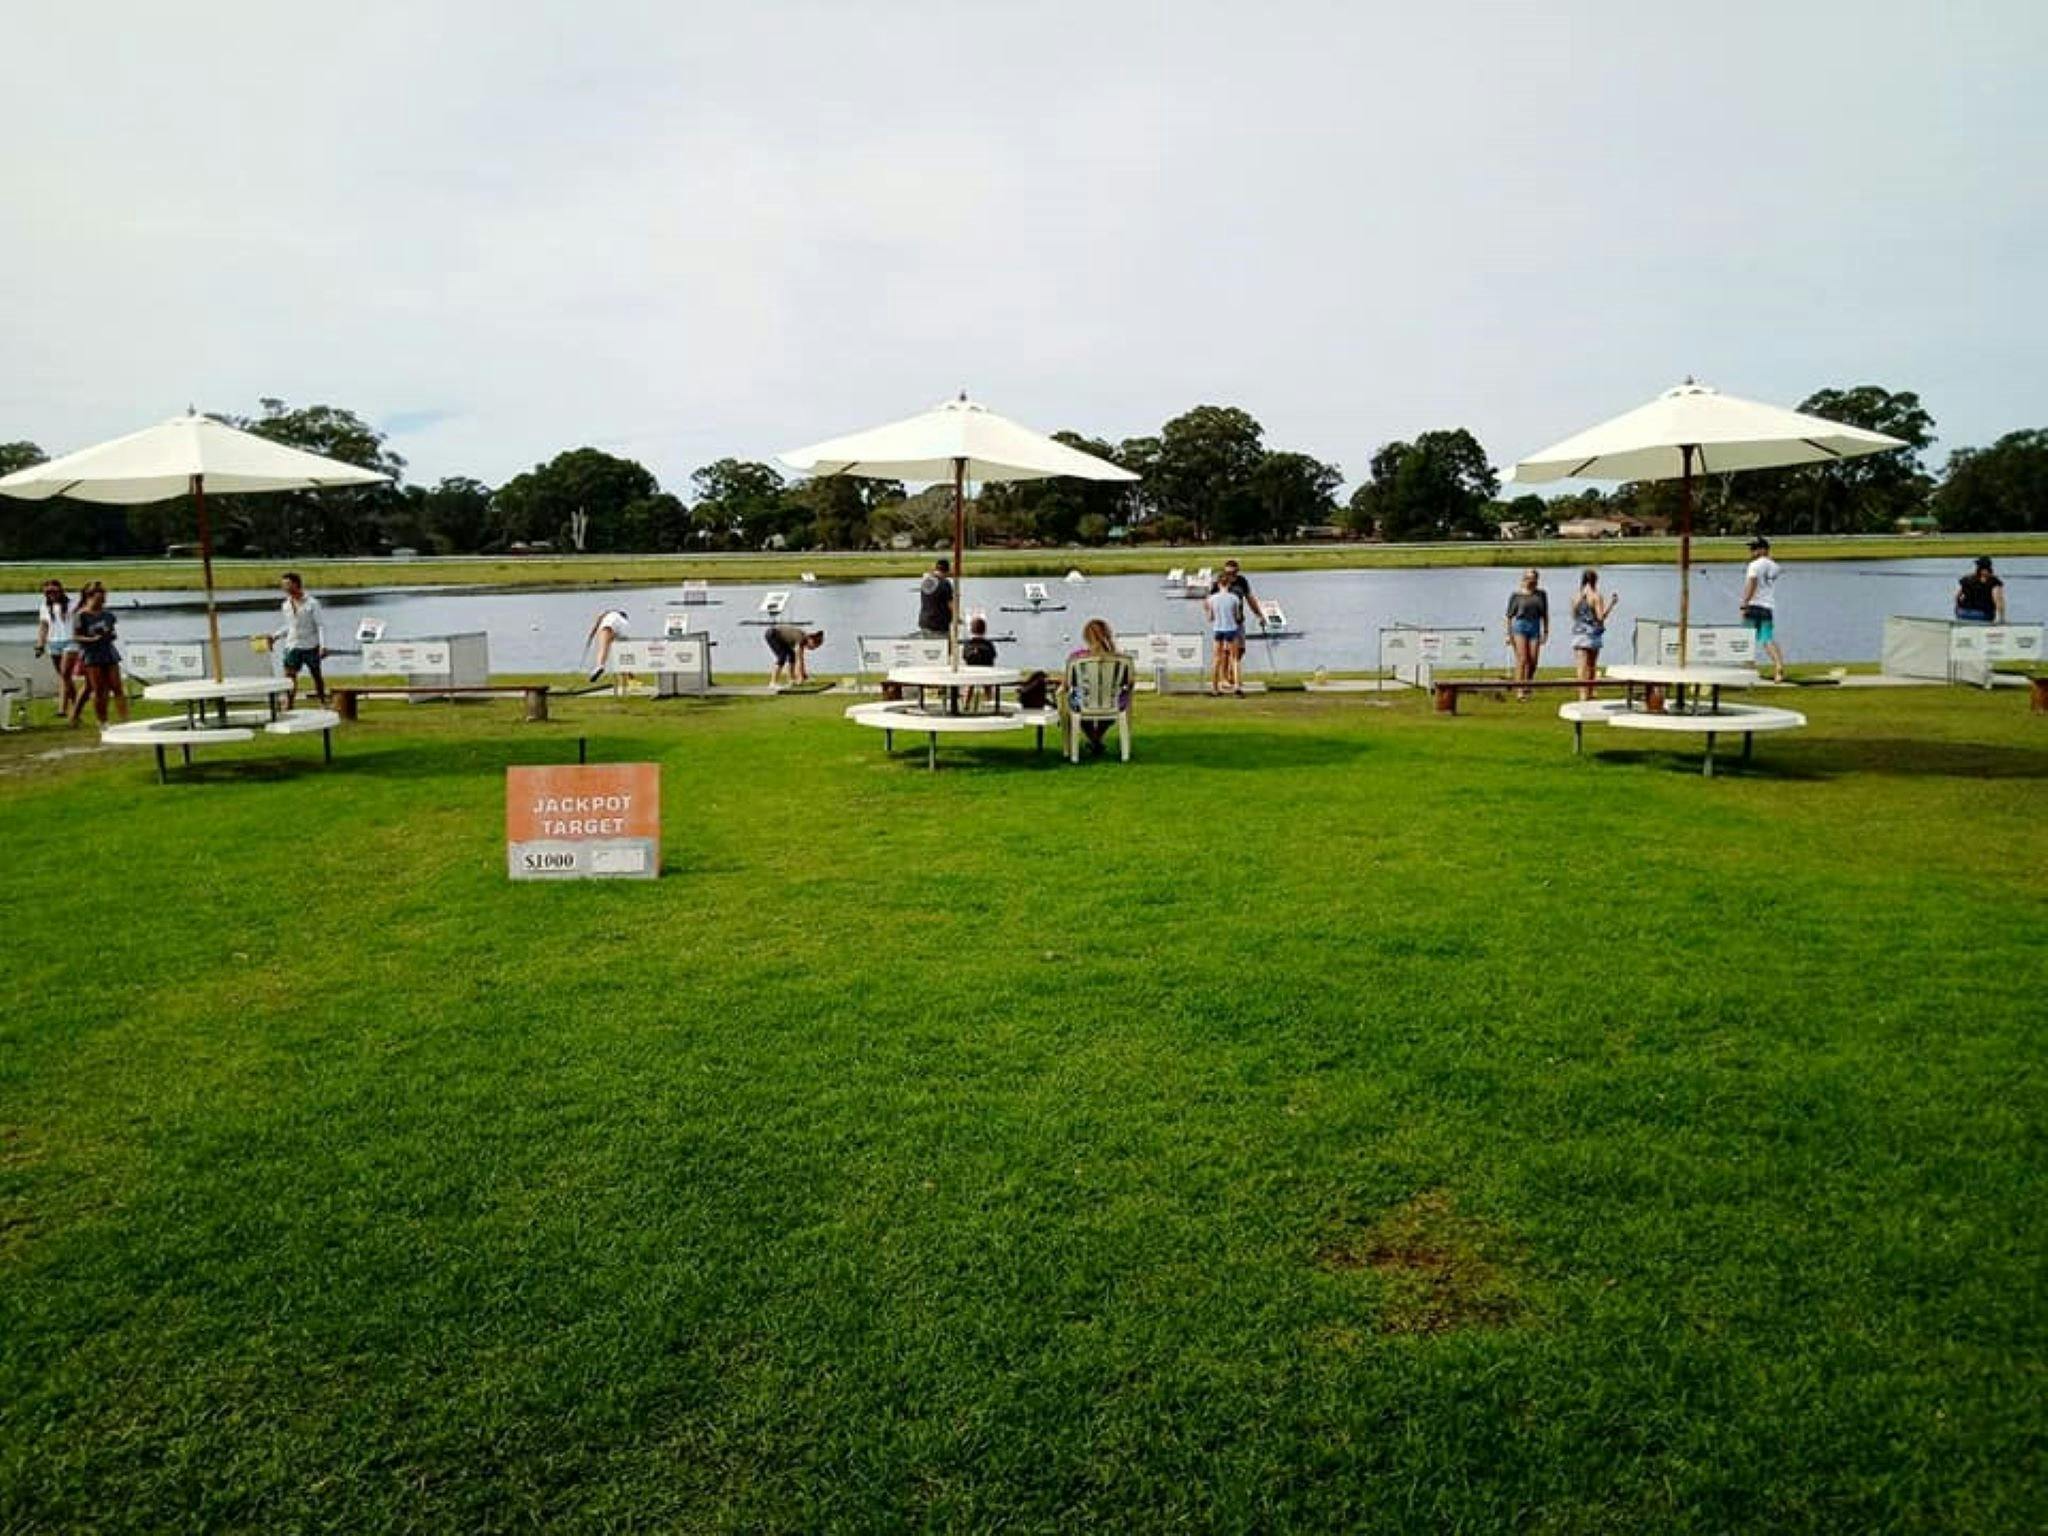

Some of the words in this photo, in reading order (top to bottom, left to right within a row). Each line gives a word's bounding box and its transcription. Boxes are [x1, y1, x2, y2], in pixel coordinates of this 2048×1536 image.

[532, 795, 631, 813] JACKPOT
[544, 818, 624, 835] TARGET
[525, 853, 574, 869] $1000
